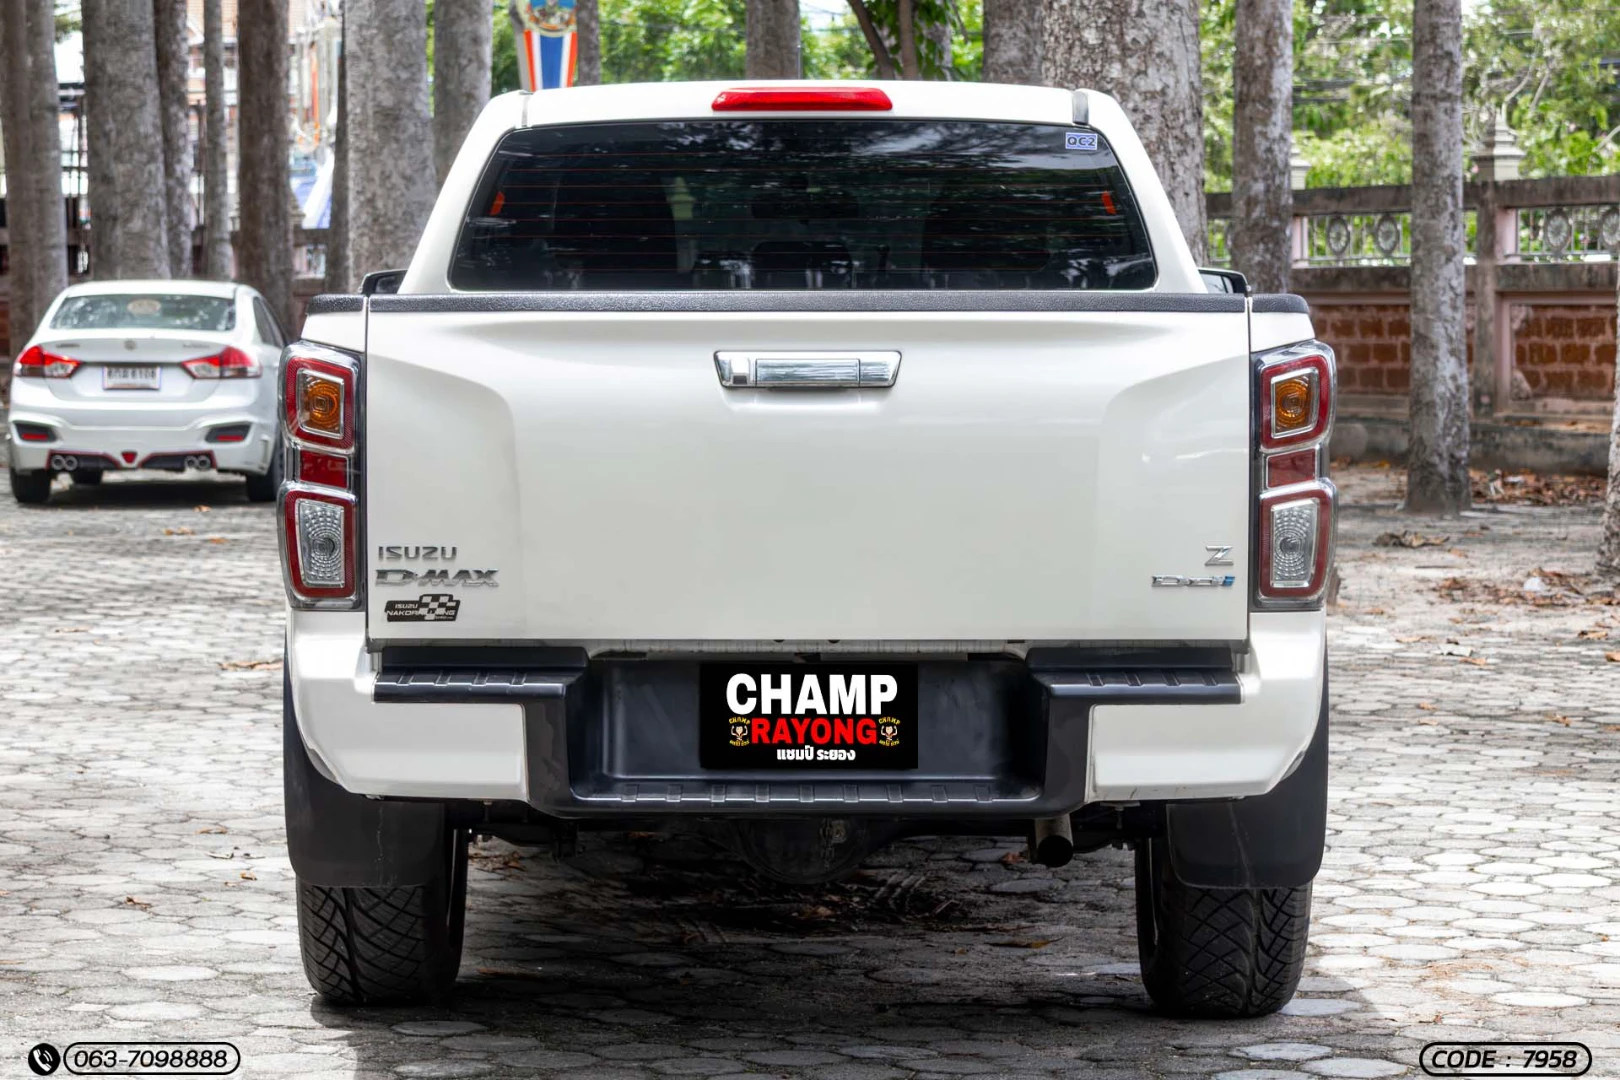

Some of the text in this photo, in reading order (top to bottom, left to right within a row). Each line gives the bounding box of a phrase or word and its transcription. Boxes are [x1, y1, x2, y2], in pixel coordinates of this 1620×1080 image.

[378, 546, 457, 560] ISUZU
[1204, 545, 1234, 566] Z
[375, 569, 500, 587] D-MAX
